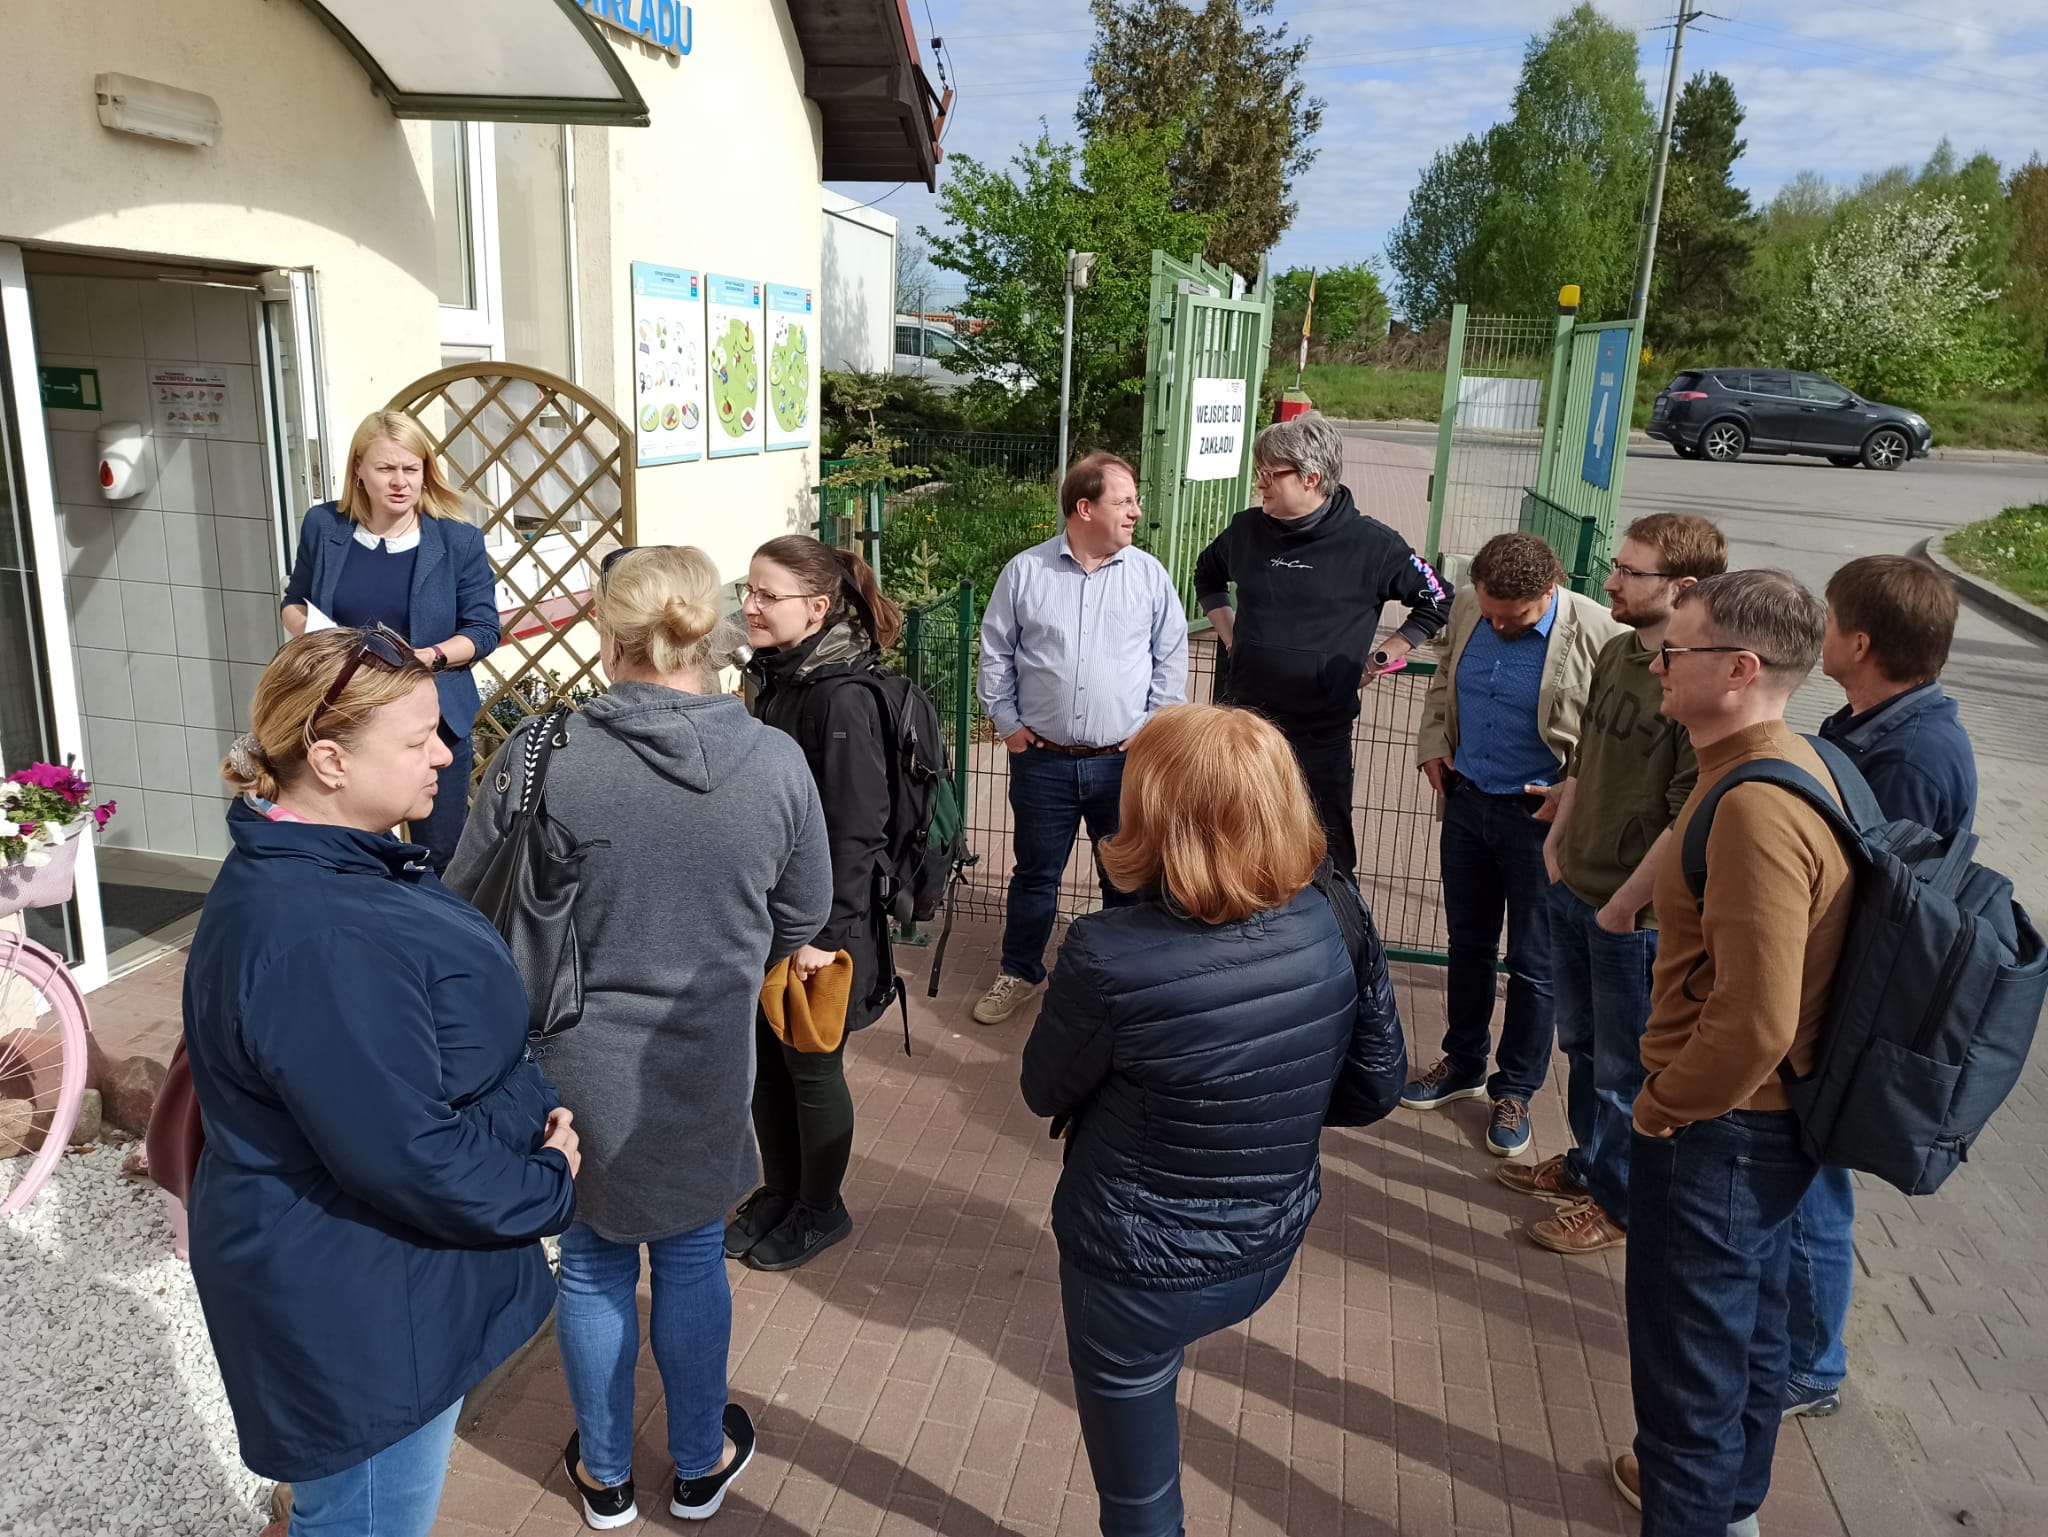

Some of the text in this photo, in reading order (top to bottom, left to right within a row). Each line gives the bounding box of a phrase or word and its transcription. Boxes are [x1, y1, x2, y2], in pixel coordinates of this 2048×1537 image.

[1196, 402, 1242, 423] WEJŚCIE DO
[1200, 436, 1234, 454] ZAKŁADU
